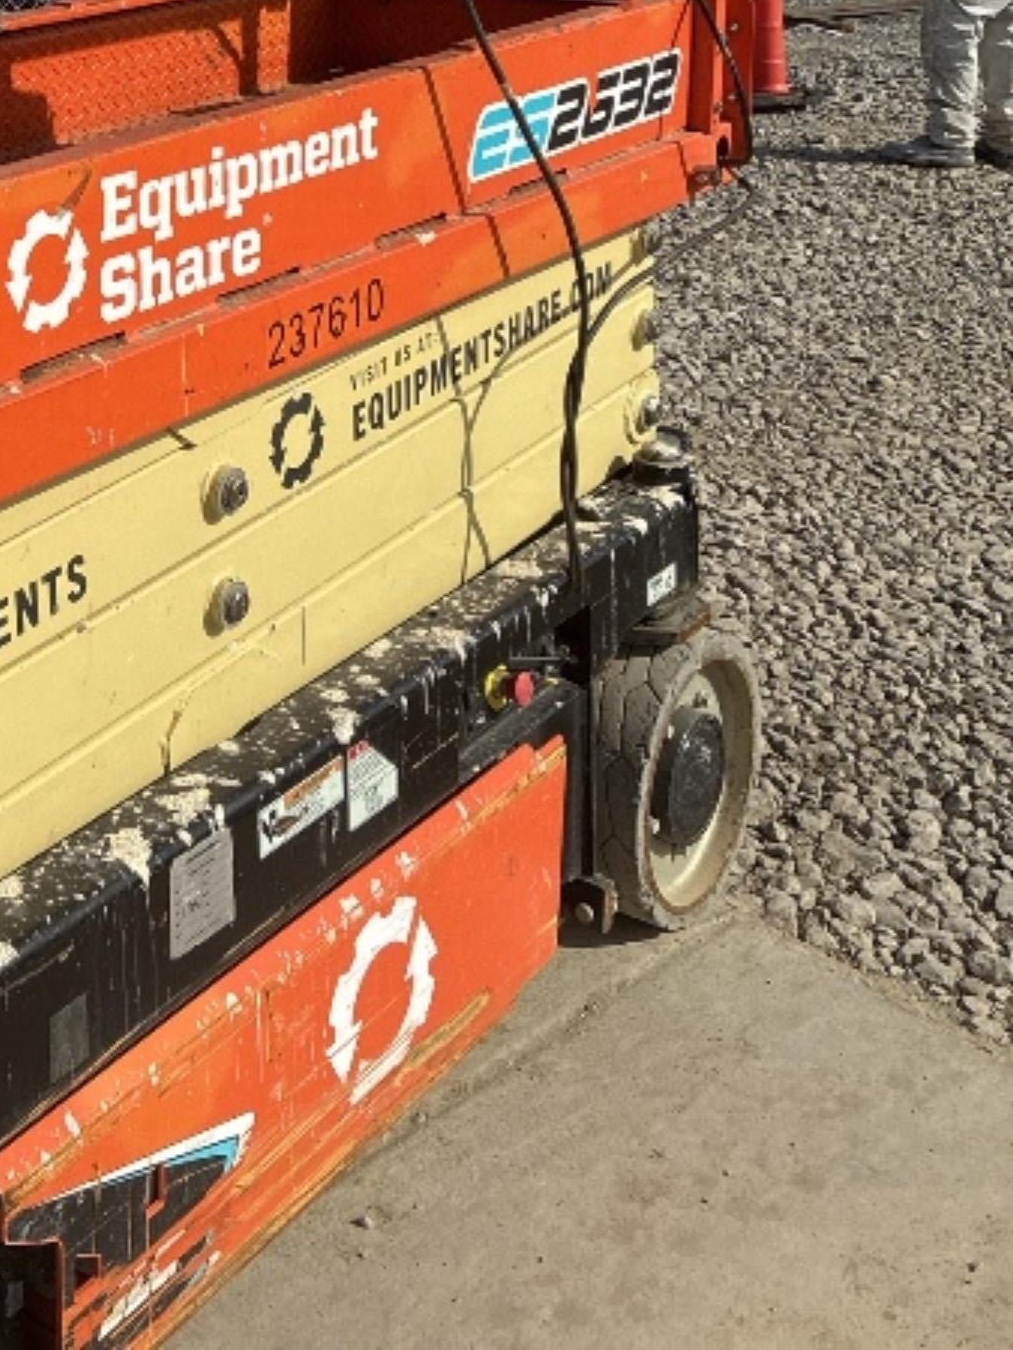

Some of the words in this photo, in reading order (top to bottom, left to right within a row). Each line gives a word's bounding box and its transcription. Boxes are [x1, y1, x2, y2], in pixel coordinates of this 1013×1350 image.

[100, 107, 378, 243] Equipment
[468, 48, 681, 183] ES2632
[100, 228, 261, 323] Share
[268, 278, 384, 369] 237610
[352, 261, 613, 441] EQUIPMENTSHARE.COM
